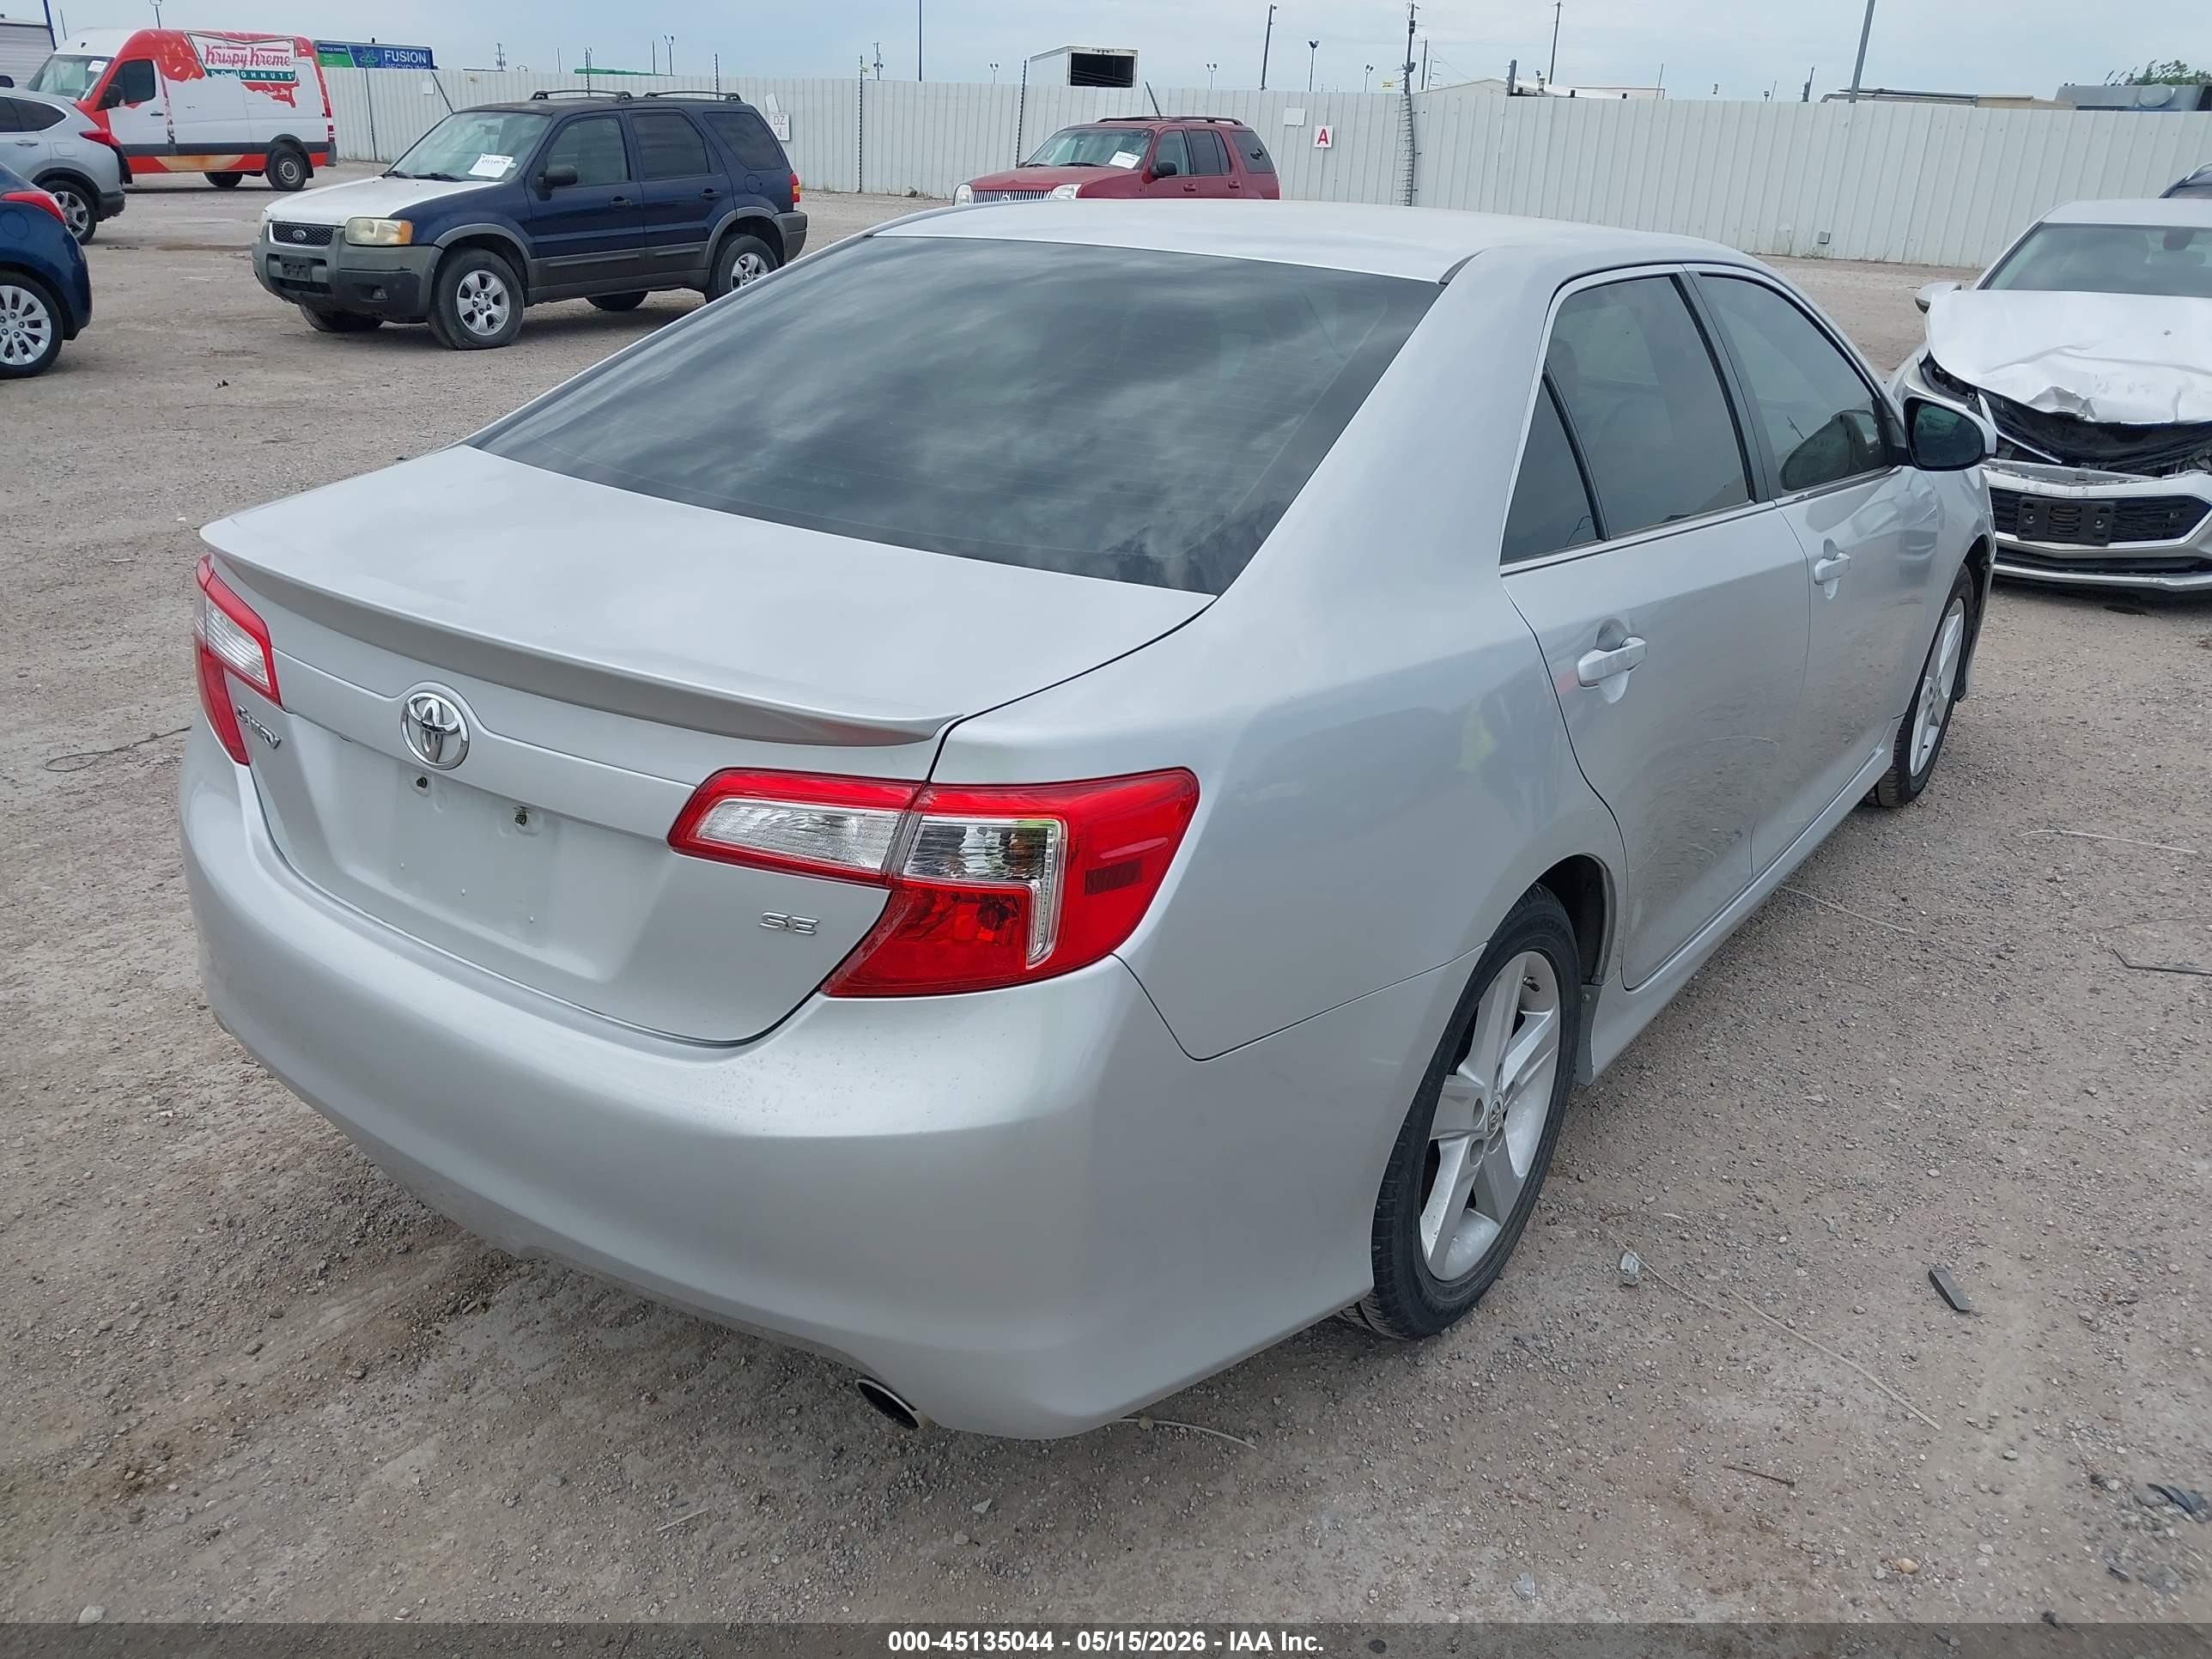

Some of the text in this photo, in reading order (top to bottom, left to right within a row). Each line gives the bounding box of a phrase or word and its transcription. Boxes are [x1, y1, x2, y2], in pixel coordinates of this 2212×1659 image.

[205, 45, 290, 68] Krispy Kreme
[384, 50, 427, 64] FUSION
[1316, 129, 1328, 144] A
[759, 911, 819, 935] SE
